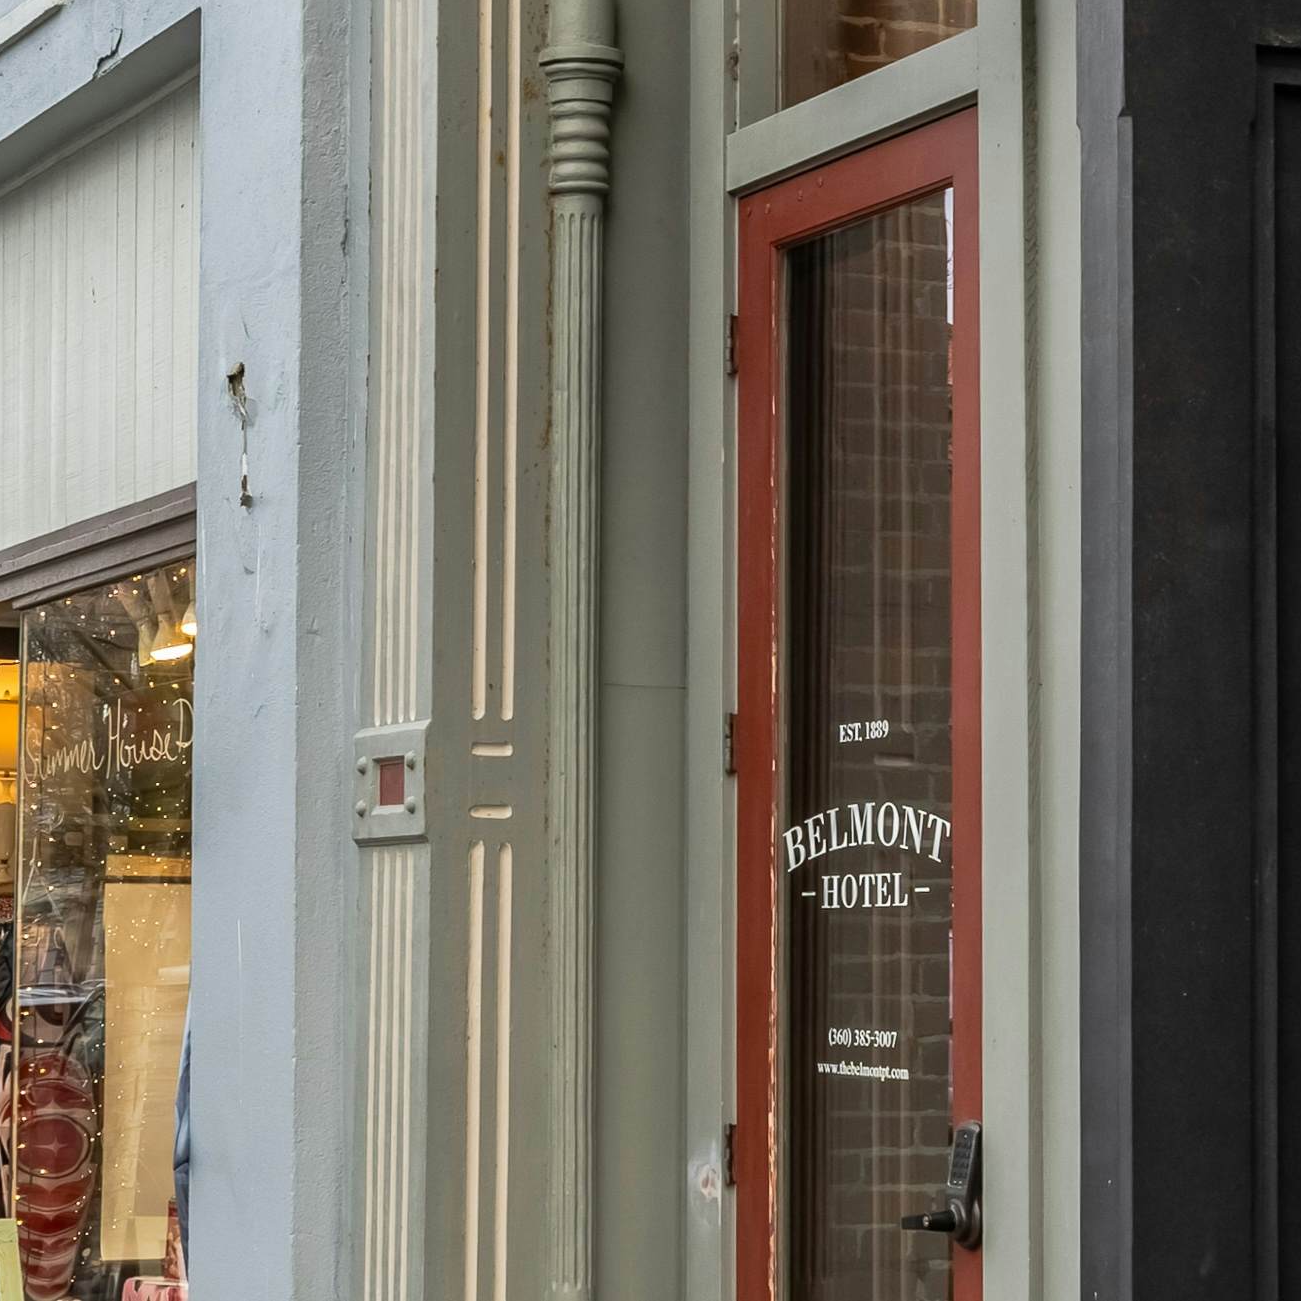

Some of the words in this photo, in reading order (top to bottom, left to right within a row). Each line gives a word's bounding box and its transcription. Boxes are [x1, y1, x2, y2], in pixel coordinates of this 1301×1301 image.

[23, 726, 105, 785] Summer
[105, 698, 178, 780] House
[838, 721, 863, 743] EST.
[865, 719, 890, 740] 1889
[782, 802, 951, 873] BELMONT
[828, 1028, 851, 1048] (360)
[853, 1029, 898, 1048] 385-3007
[817, 1060, 910, 1082] www.thebelmontpt.com
